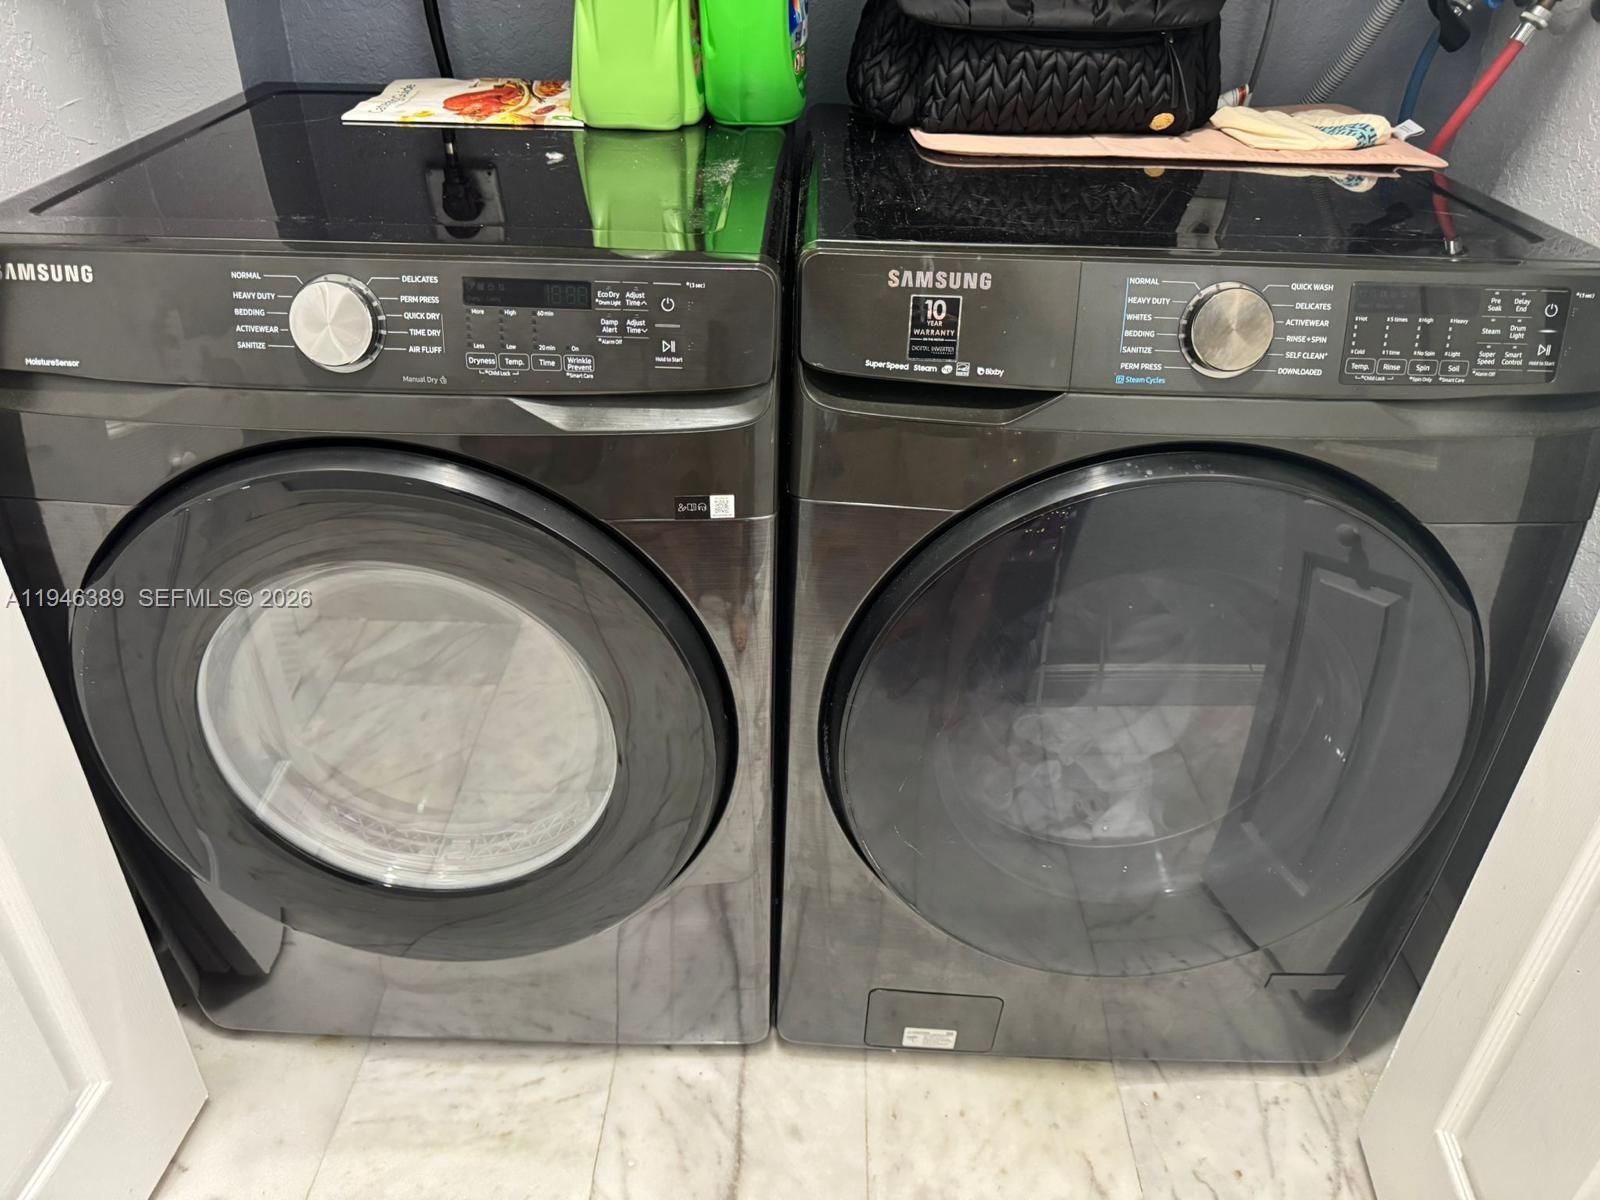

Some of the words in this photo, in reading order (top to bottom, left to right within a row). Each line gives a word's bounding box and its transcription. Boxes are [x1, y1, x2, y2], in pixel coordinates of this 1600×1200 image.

[0, 262, 94, 283] AMSUNG
[231, 271, 261, 280] NORMAL
[401, 275, 438, 284] DELICATES
[888, 270, 992, 290] SAMSUNG
[1130, 277, 1159, 285] NORMAL
[1291, 283, 1312, 291] QUICK
[1313, 283, 1334, 292] WASH
[232, 291, 256, 300] HEAVY
[256, 292, 276, 300] DUTY
[626, 291, 645, 299] Adjust
[400, 295, 418, 303] PERM
[420, 296, 440, 304] PRESS
[1514, 298, 1531, 306] Delay
[925, 300, 947, 320] 10
[1295, 302, 1332, 310] DELICATES
[234, 308, 266, 316] BEDDING
[404, 312, 424, 320] QUICK
[426, 312, 440, 320] DRY
[600, 318, 618, 326] Damp
[1285, 319, 1329, 327] ACTIVEWEAR
[236, 325, 279, 333] ACTIVEWEAR
[409, 328, 426, 336] TIME
[1124, 330, 1155, 338] BEDDING
[1509, 332, 1525, 340] Light
[237, 342, 266, 350] SANITIZE
[422, 346, 442, 354] FLUFF
[1122, 346, 1152, 354] SANITIZE
[468, 356, 496, 365] Dryness
[505, 358, 525, 366] Temp.
[1477, 358, 1495, 366] Speed
[1501, 358, 1523, 366] Control
[914, 364, 937, 372] Steam
[1120, 362, 1140, 370] PERM
[1351, 362, 1369, 370] Temp.
[1416, 364, 1430, 372] Spin
[985, 368, 1004, 377] Bixby
[1278, 368, 1322, 376] DOWNLOADED
[426, 376, 438, 384] Dry
